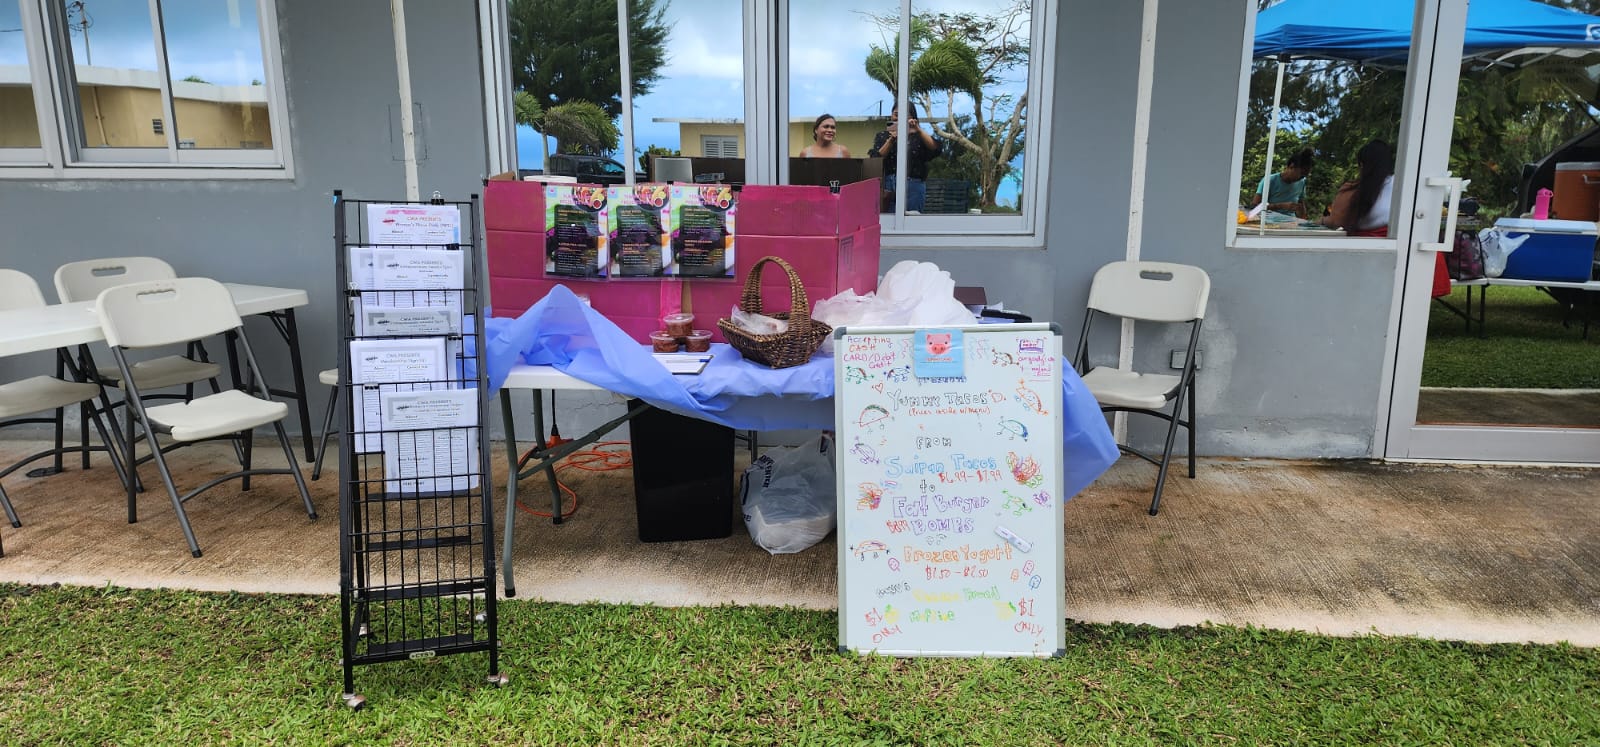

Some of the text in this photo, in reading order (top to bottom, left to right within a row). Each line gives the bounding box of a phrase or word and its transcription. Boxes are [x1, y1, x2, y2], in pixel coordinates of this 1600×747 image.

[903, 540, 1013, 564] Frozen Yogurt
[1017, 597, 1036, 617] $1
[1014, 620, 1045, 637] ONLY
